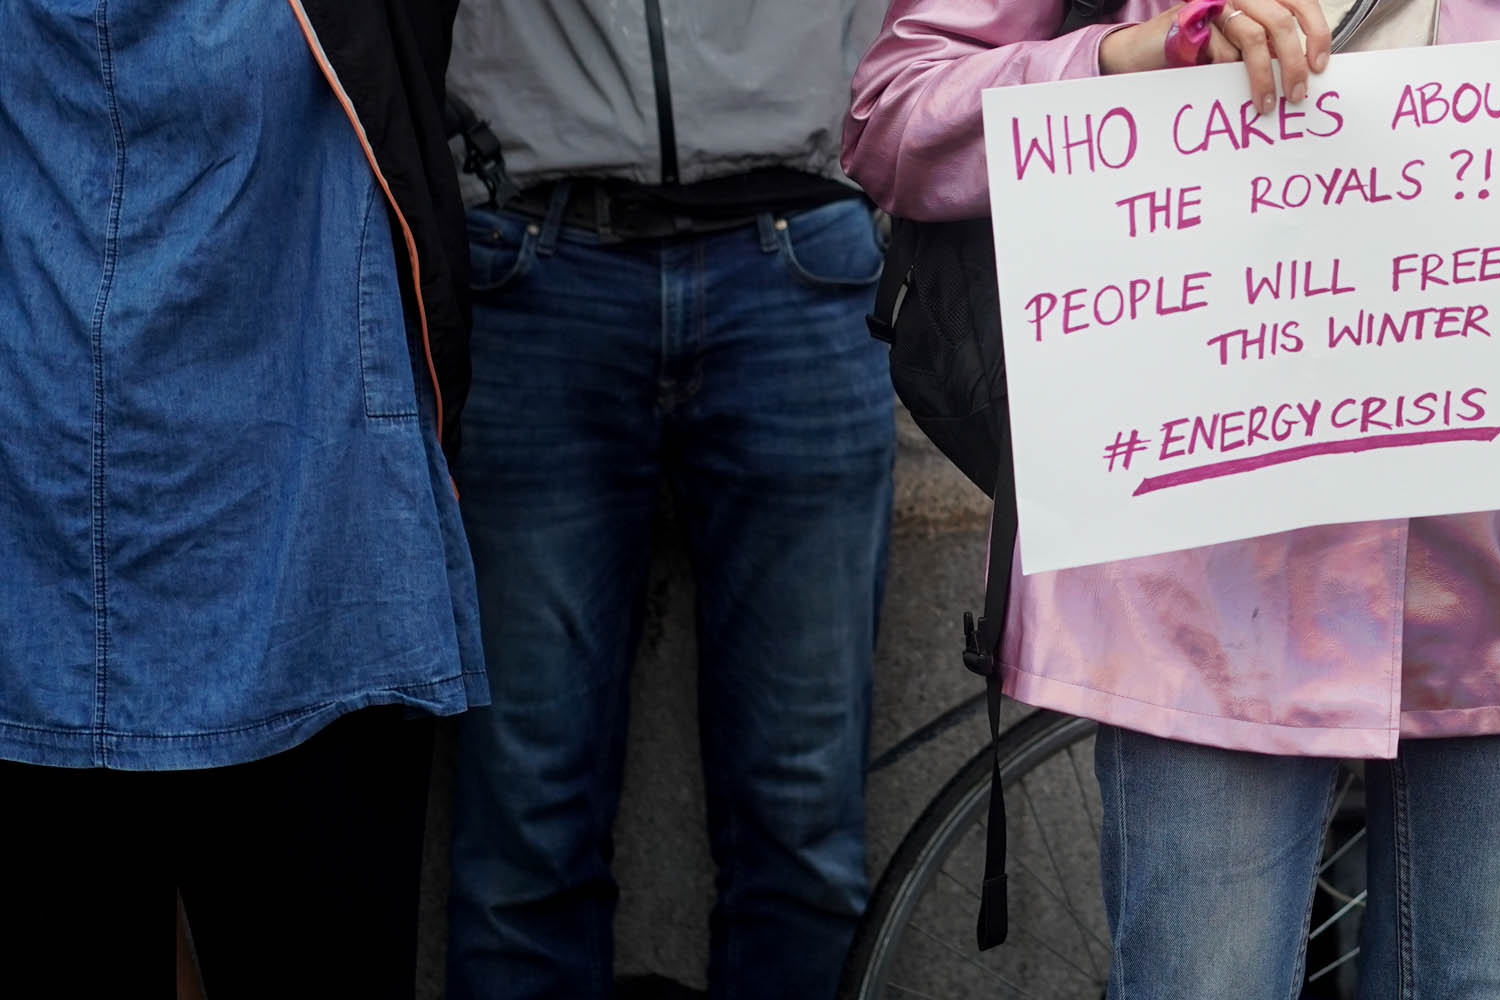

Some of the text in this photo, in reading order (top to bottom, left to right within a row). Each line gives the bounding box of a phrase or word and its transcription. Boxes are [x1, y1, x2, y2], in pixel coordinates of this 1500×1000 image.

[1012, 107, 1137, 180] WHO
[1173, 91, 1344, 155] CARES
[1117, 186, 1202, 237] THE
[1025, 272, 1212, 342] PEOPLE
[1246, 259, 1355, 304] WILL
[1208, 305, 1491, 365] THIS WINTER
